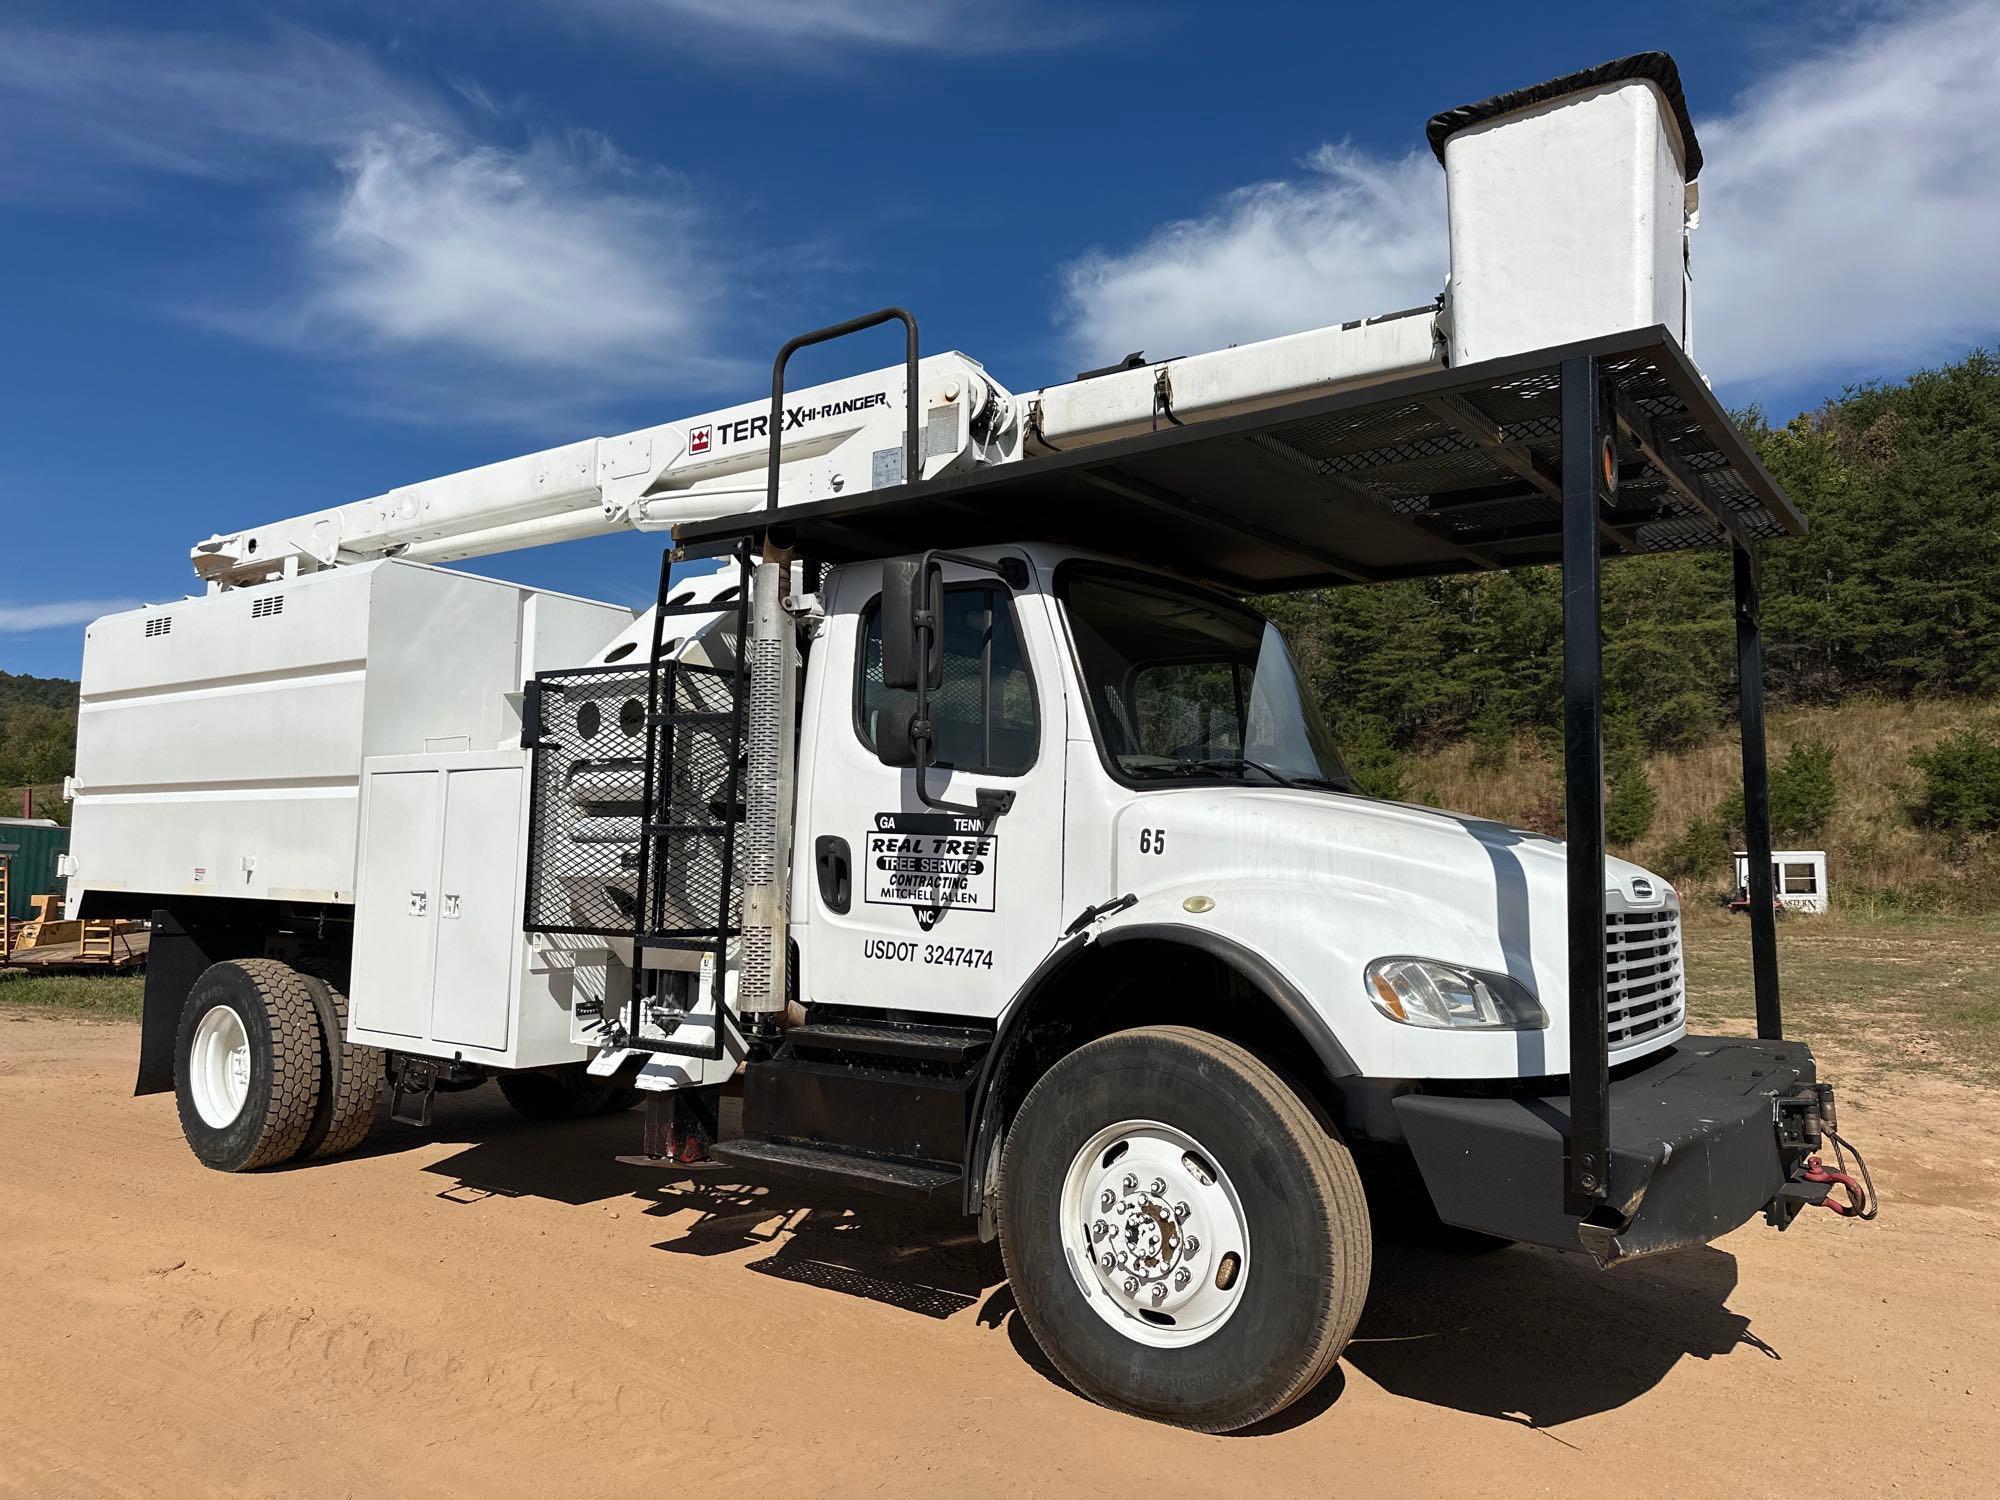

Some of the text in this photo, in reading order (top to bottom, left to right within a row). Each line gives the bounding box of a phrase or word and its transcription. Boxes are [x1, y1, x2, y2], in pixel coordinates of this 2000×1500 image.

[717, 392, 886, 445] TERX HI-RANGER
[879, 816, 896, 829] GA
[954, 818, 985, 832] TENN
[871, 838, 991, 856] REAL TREE
[1140, 828, 1165, 855] 65
[883, 857, 977, 874] TREE SERVICE
[889, 873, 969, 890] CONTRACTING
[880, 888, 977, 904] MITCHELL ALLEN
[918, 910, 935, 923] NC
[864, 939, 993, 970] USDOT 3247474
